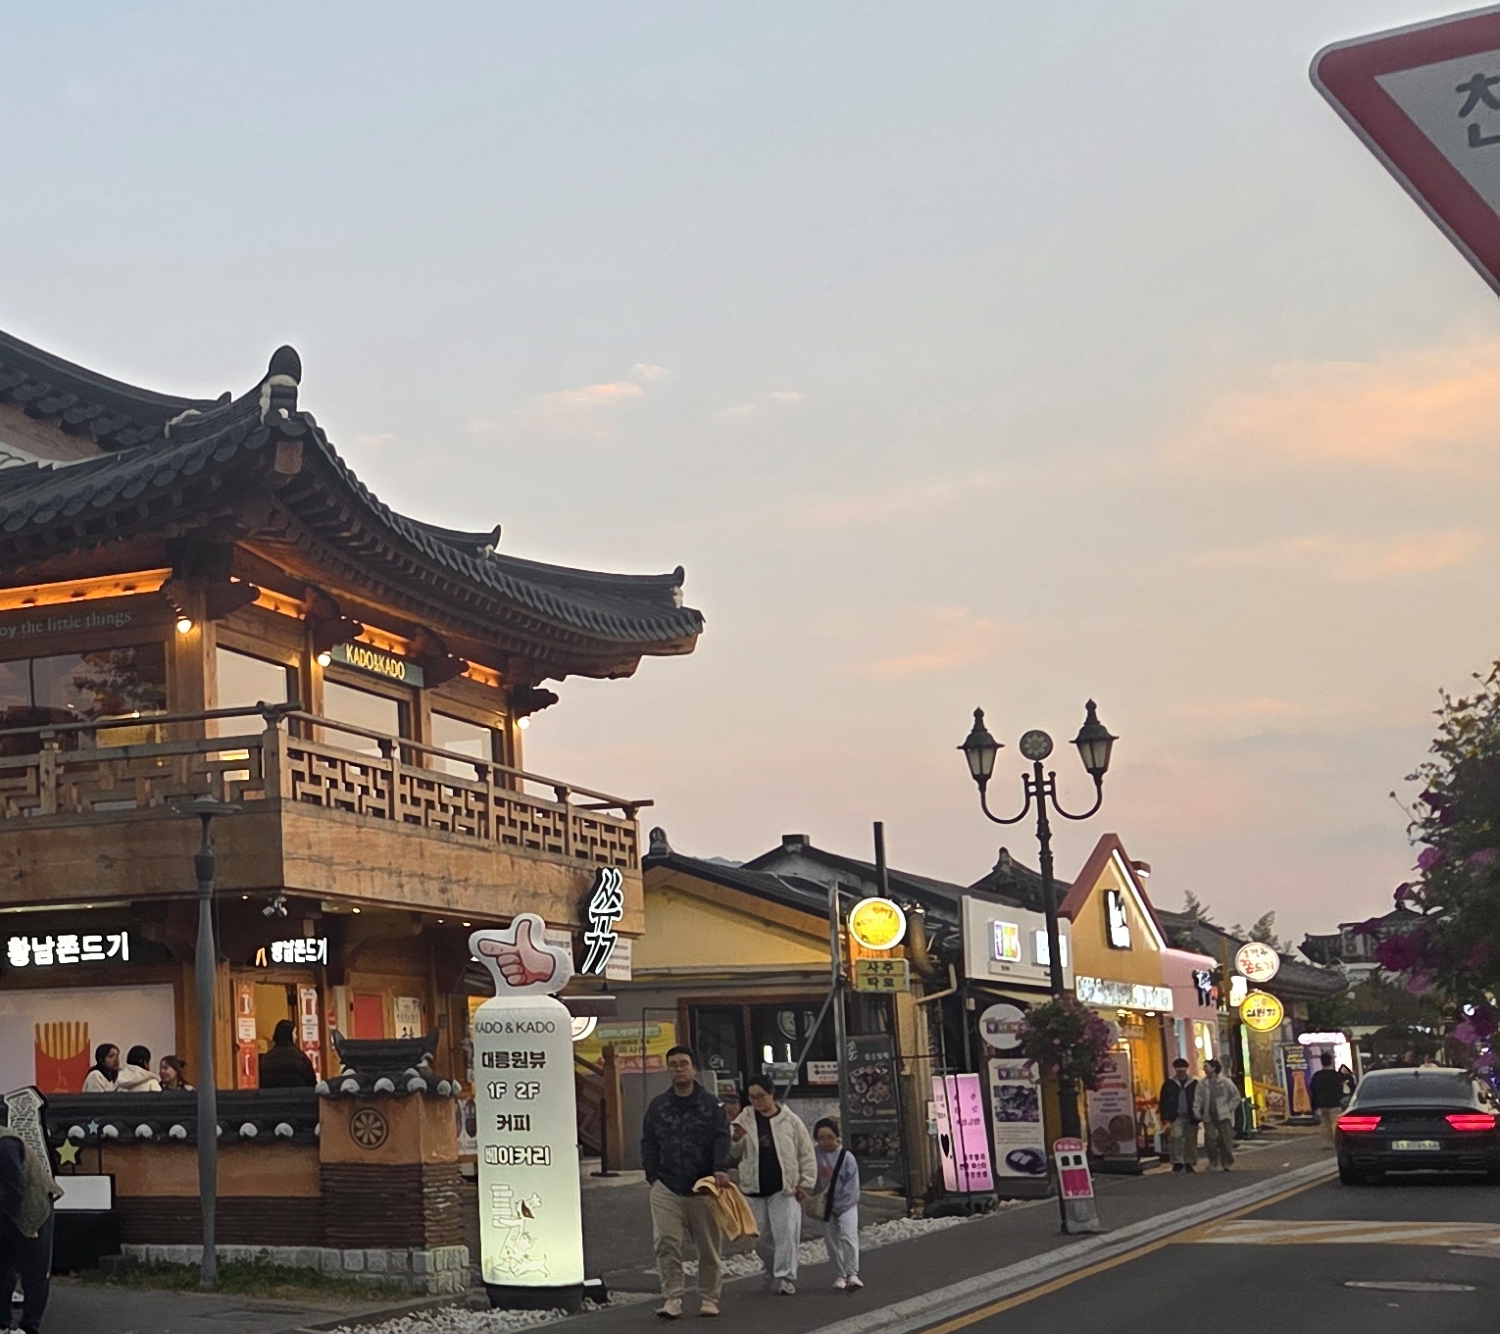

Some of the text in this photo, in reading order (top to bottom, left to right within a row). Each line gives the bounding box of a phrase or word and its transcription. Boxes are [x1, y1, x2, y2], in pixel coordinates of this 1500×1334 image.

[21, 619, 43, 634] the
[47, 614, 82, 632] little
[85, 611, 132, 628] things
[7, 931, 130, 967] 황남쫀드기
[271, 937, 329, 965] 황남쫀드기
[867, 961, 894, 974] 사주
[1241, 958, 1275, 974] 쫀드기
[475, 1021, 556, 1034] KADO & KADO
[482, 1051, 547, 1069] 대릉원뷰
[487, 1081, 540, 1100] 1F 2F
[496, 1114, 531, 1132] 커피
[484, 1145, 551, 1166] 베이커리
